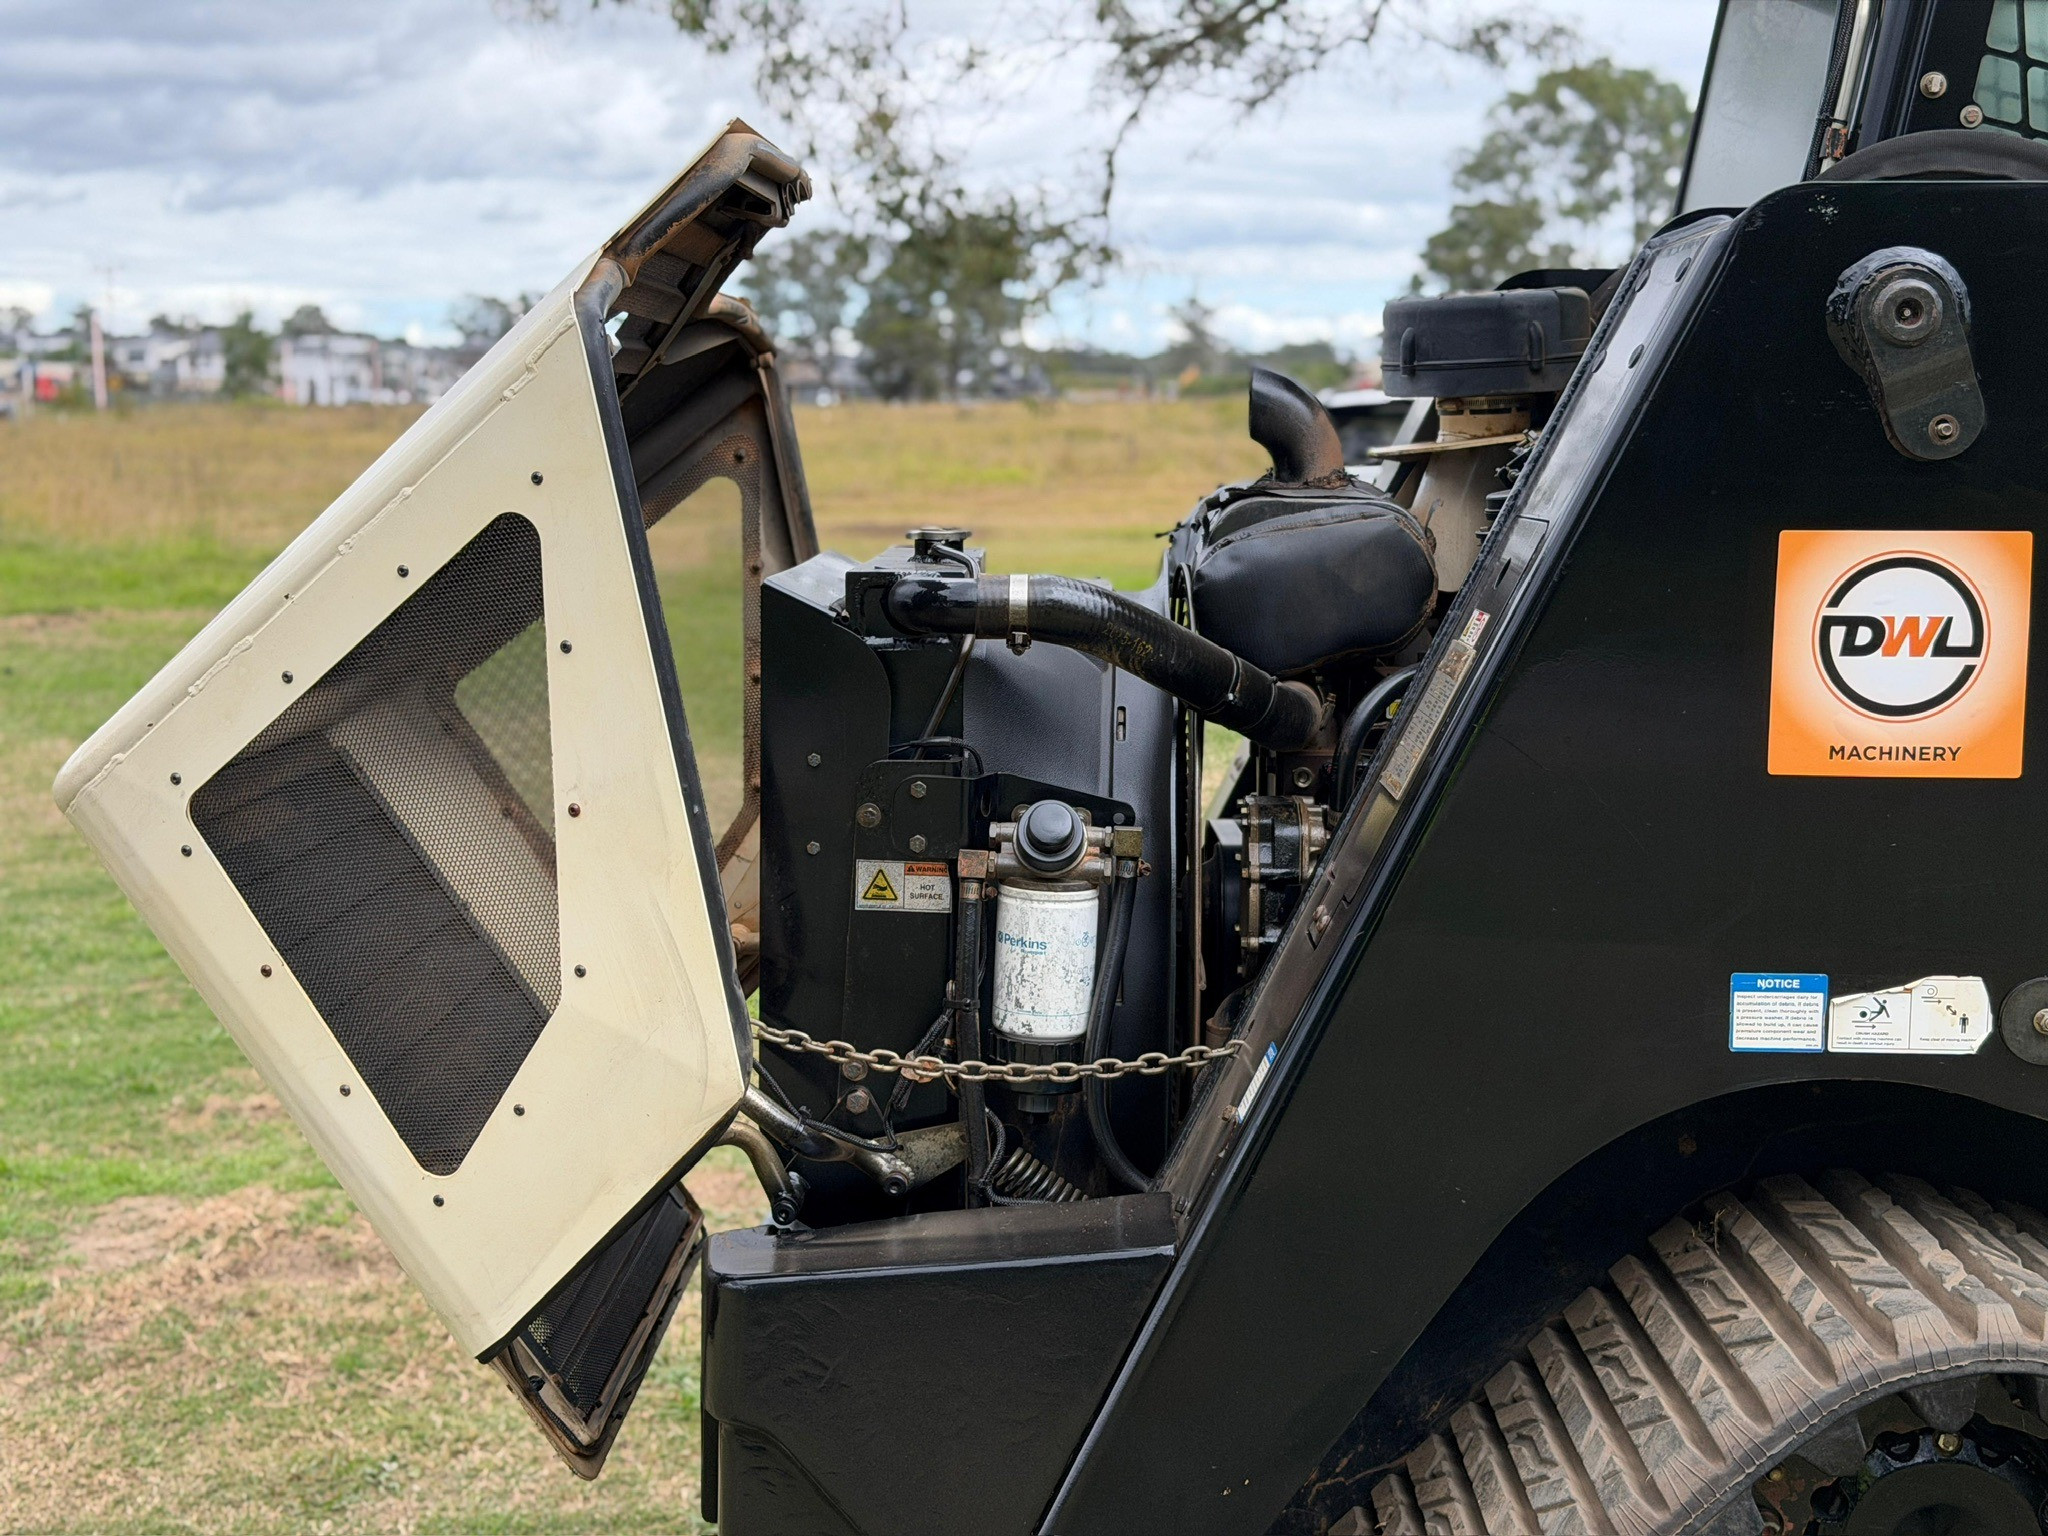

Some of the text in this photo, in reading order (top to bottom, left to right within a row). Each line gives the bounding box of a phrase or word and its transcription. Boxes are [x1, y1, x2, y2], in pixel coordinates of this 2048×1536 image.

[1819, 615, 1981, 657] DWL
[1828, 745, 1962, 762] MACHINERY
[909, 892, 943, 900] SURFACE
[1004, 932, 1048, 950] Perkins
[1757, 979, 1801, 989] NOTICE
